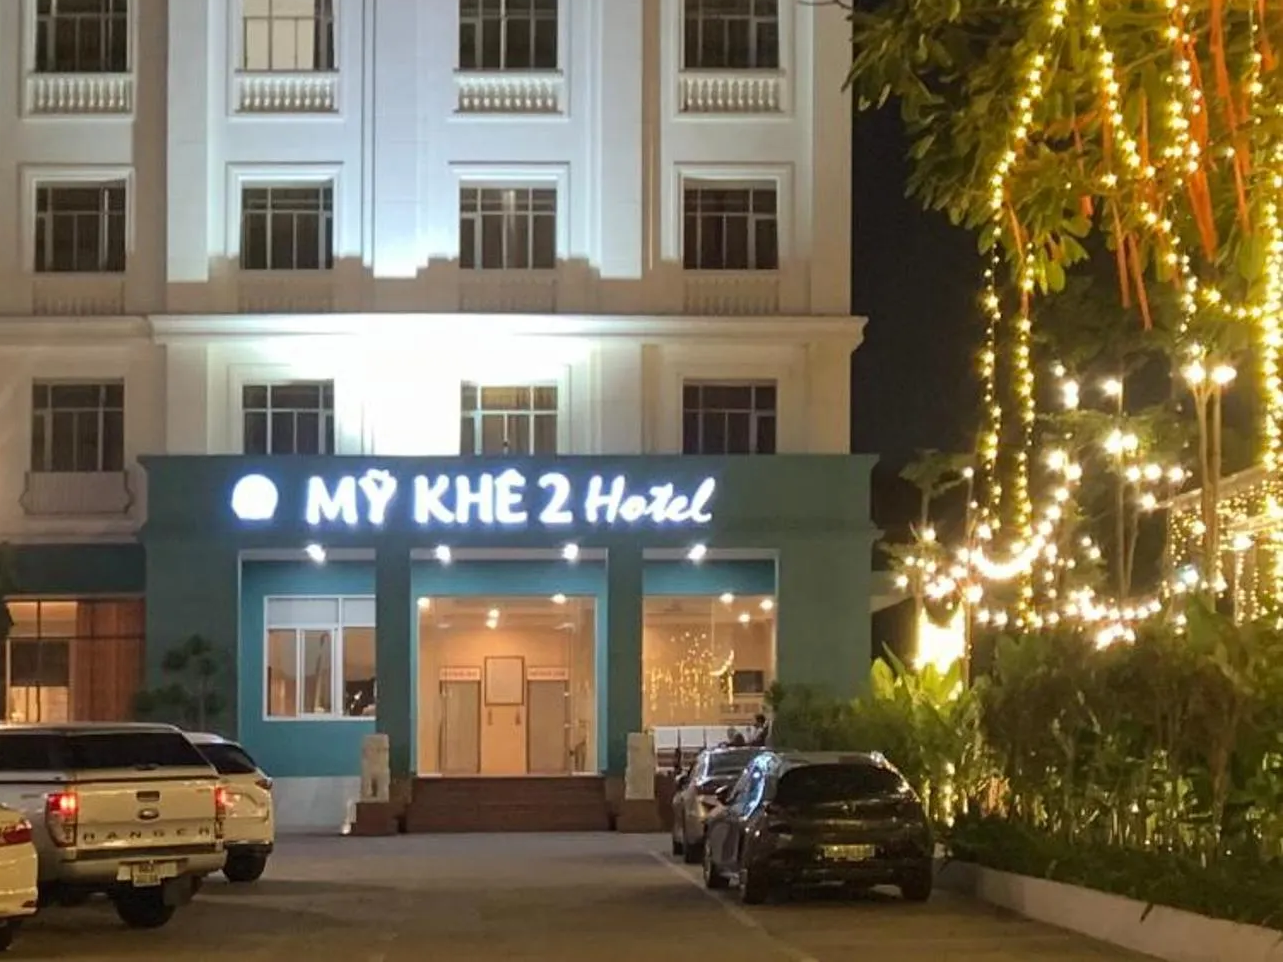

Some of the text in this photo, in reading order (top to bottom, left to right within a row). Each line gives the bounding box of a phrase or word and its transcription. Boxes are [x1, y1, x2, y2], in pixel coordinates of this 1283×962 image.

[306, 468, 716, 525] MỸ KHÊ 2 Hotel
